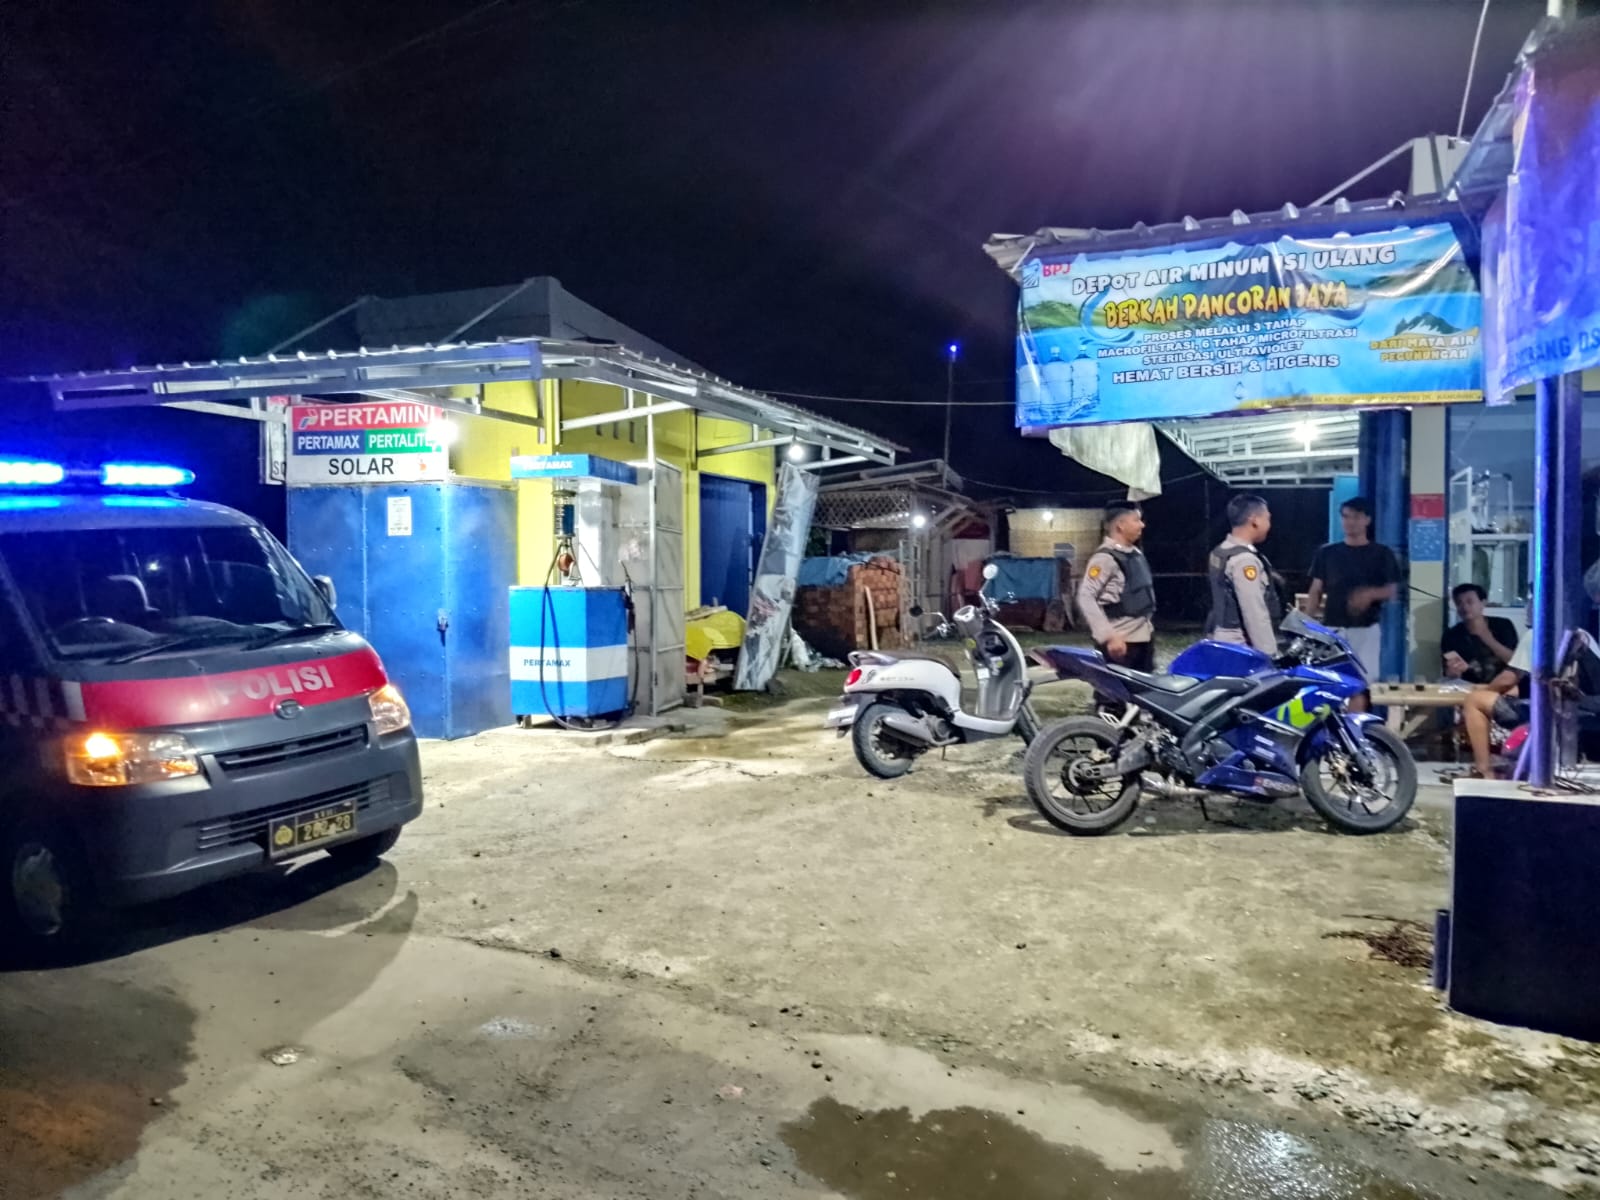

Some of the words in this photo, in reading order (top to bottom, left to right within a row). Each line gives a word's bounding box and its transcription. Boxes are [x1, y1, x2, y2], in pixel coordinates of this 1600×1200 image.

[1042, 263, 1072, 277] BPJ
[1072, 272, 1140, 295] DEPOT
[1144, 267, 1183, 287] AIR
[1190, 255, 1270, 282] MINUM
[1312, 244, 1397, 269] ULANG
[1104, 294, 1179, 329] BERKAH
[1182, 284, 1291, 320] PANCORAN
[1143, 329, 1193, 344] PROSES
[1195, 323, 1251, 338] MELALUI
[1254, 322, 1262, 332] 3
[1264, 318, 1306, 331] TAHAP
[1202, 341, 1210, 350] 6
[1214, 335, 1256, 349] TAHAP
[1257, 327, 1358, 345] MICROFILTRASI
[1450, 335, 1476, 347] AIR
[1143, 348, 1215, 366] STERILSASI
[1218, 340, 1304, 359] ULTRAVIOLET
[1112, 367, 1174, 385] HEMAT
[1176, 361, 1243, 380] BERSIH
[1247, 359, 1262, 373] &
[1264, 353, 1341, 371] HIGENIS
[298, 433, 360, 450] PERTAMAX
[328, 457, 394, 475] SOLAR
[208, 665, 335, 706] POLISI
